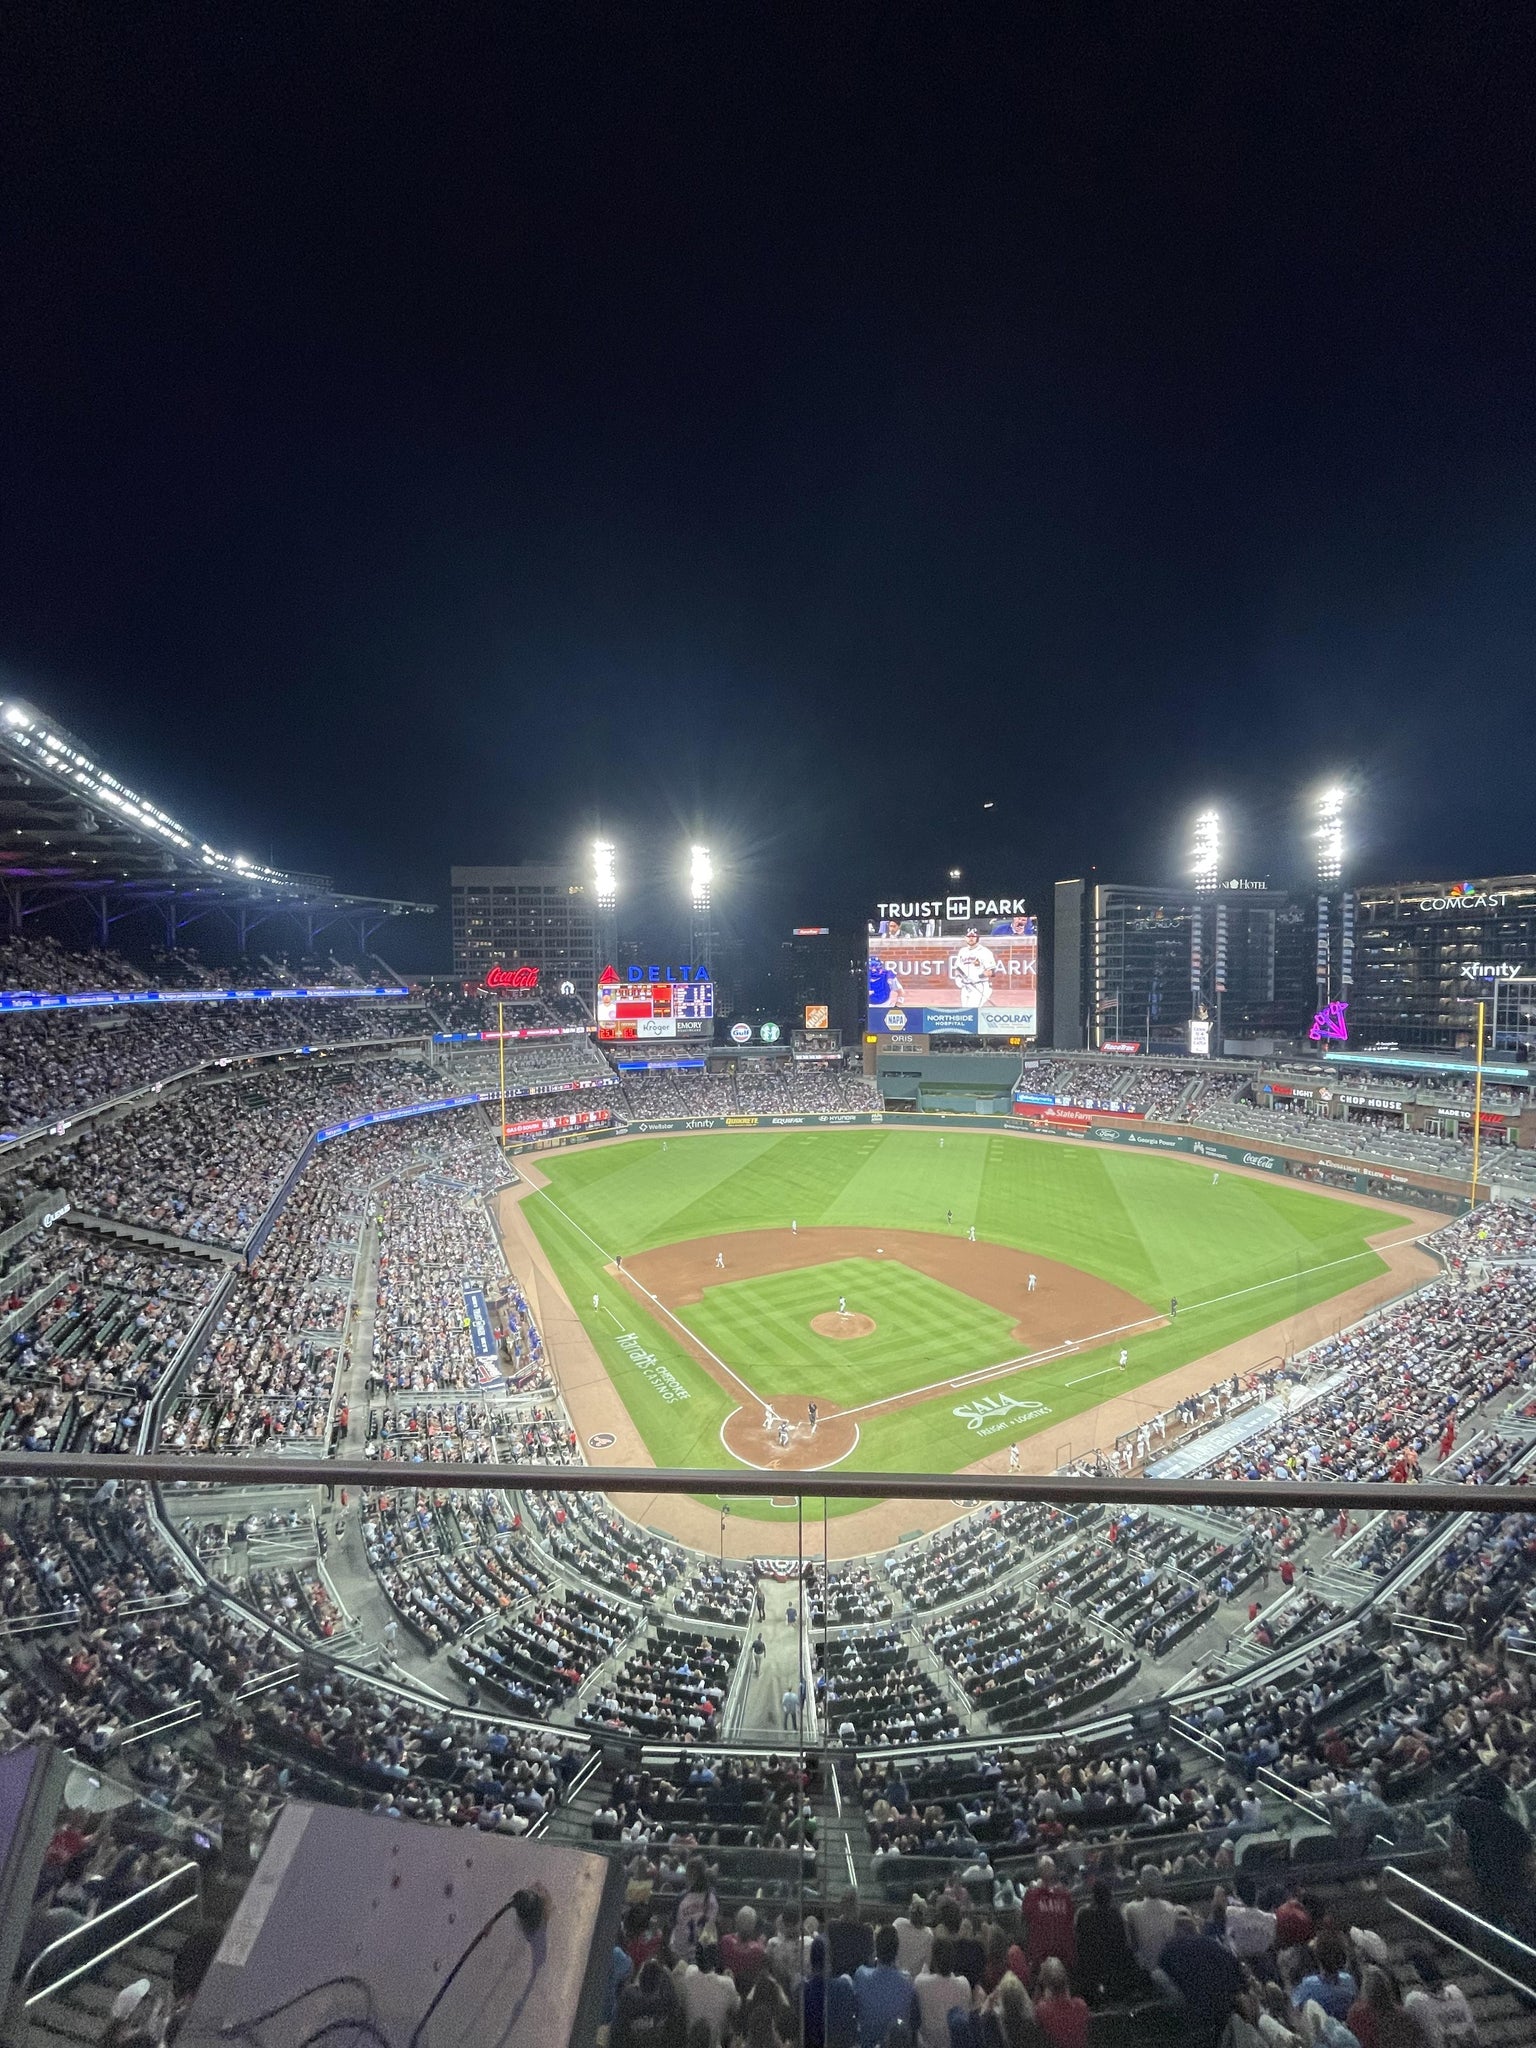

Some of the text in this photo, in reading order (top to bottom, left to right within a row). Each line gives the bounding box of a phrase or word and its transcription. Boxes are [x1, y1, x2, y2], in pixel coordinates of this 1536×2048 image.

[1240, 879, 1268, 889] HOTEL
[877, 899, 1026, 918] TRUIST PARK
[1420, 894, 1508, 911] COMCAST
[628, 965, 710, 982] DELTA
[884, 960, 1037, 976] RUIST ARK
[1460, 962, 1521, 980] xfinity
[888, 1016, 904, 1025] NAPA
[986, 1014, 1033, 1023] COOLRAY
[643, 1020, 669, 1035] Kroger
[1104, 1043, 1135, 1051] RaceTrac
[1293, 1089, 1313, 1098] LIGHT
[1340, 1094, 1402, 1110] CHOP HOUSE
[772, 1117, 805, 1125] EQUIFAX
[1056, 1109, 1092, 1121] State Farm
[686, 1119, 714, 1129] xfinity
[1137, 1136, 1176, 1147] Georgia Power
[643, 1370, 679, 1404] CASINOS
[656, 1366, 691, 1399] CHEROKEE
[976, 1407, 1052, 1437] FREIGHT LOGISTICS
